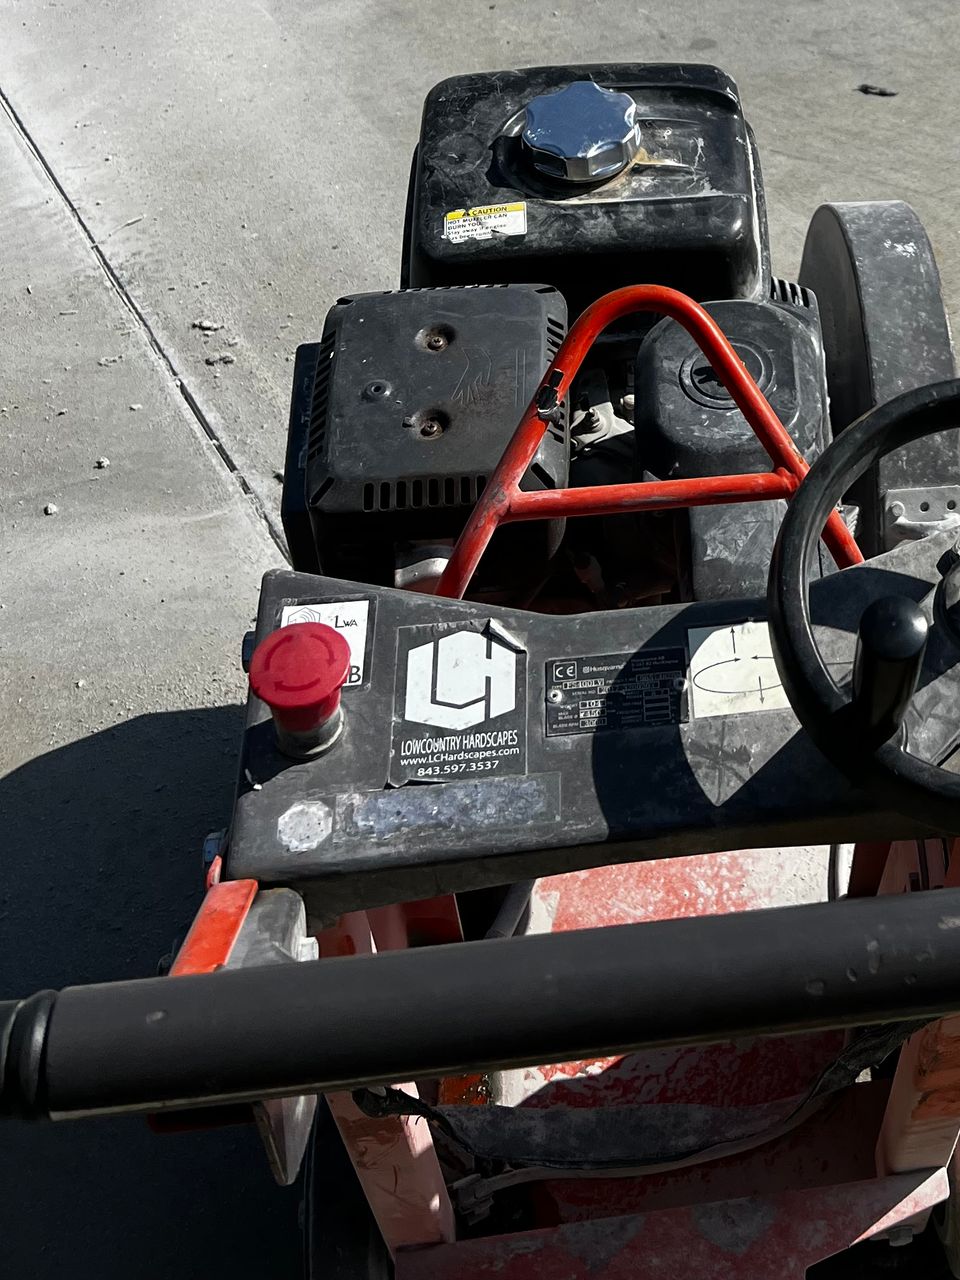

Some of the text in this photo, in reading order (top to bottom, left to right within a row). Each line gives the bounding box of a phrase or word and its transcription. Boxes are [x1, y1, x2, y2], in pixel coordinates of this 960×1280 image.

[472, 206, 508, 216] CAUTION
[555, 665, 575, 678] CE
[401, 730, 518, 756] LOWCOUNTRY HARDSCAPES
[400, 747, 520, 766] www.LCHardscapes.com
[417, 760, 499, 777] 843.597.3537
